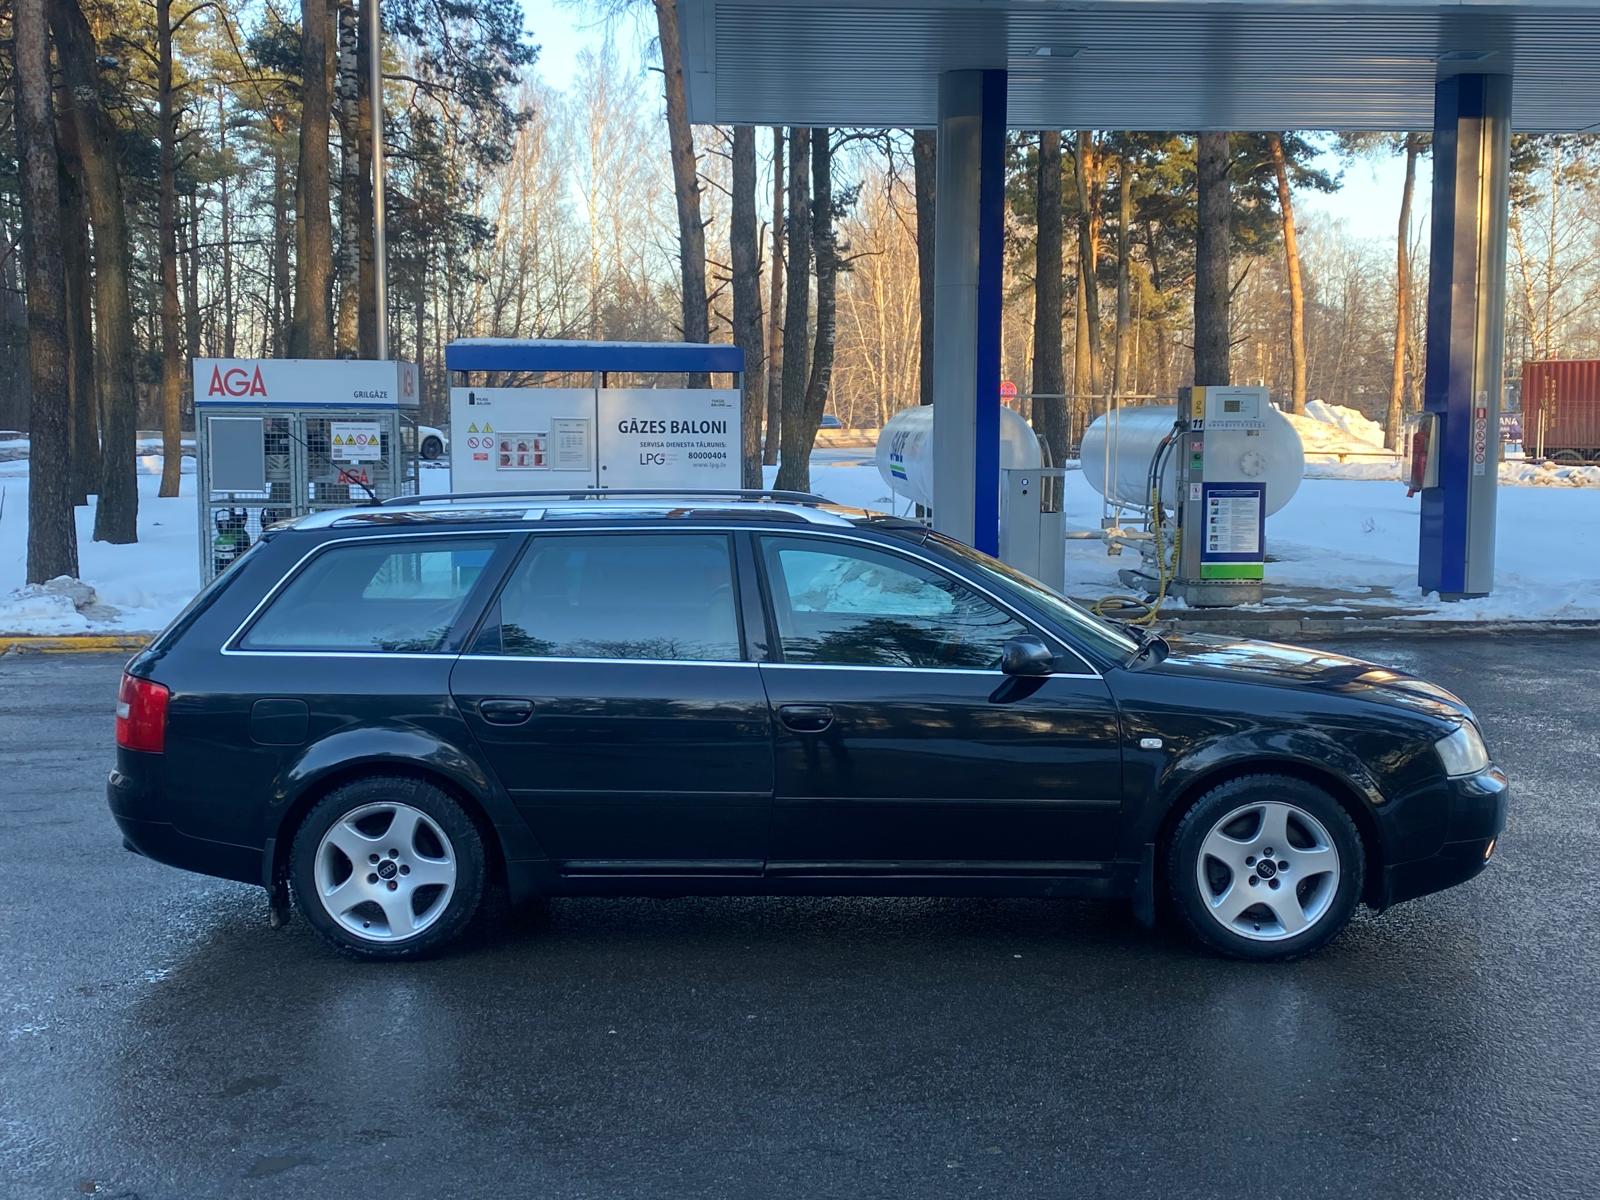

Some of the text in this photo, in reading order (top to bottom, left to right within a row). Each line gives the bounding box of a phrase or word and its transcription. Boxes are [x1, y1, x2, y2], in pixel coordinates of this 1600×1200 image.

[208, 364, 268, 397] AGA
[353, 389, 388, 399] GRILGĀZE
[618, 418, 727, 434] GĀZES BALONI
[1193, 419, 1203, 429] 11
[640, 453, 665, 466] LPG
[688, 451, 727, 460] 80000404
[337, 466, 368, 484] AGA
